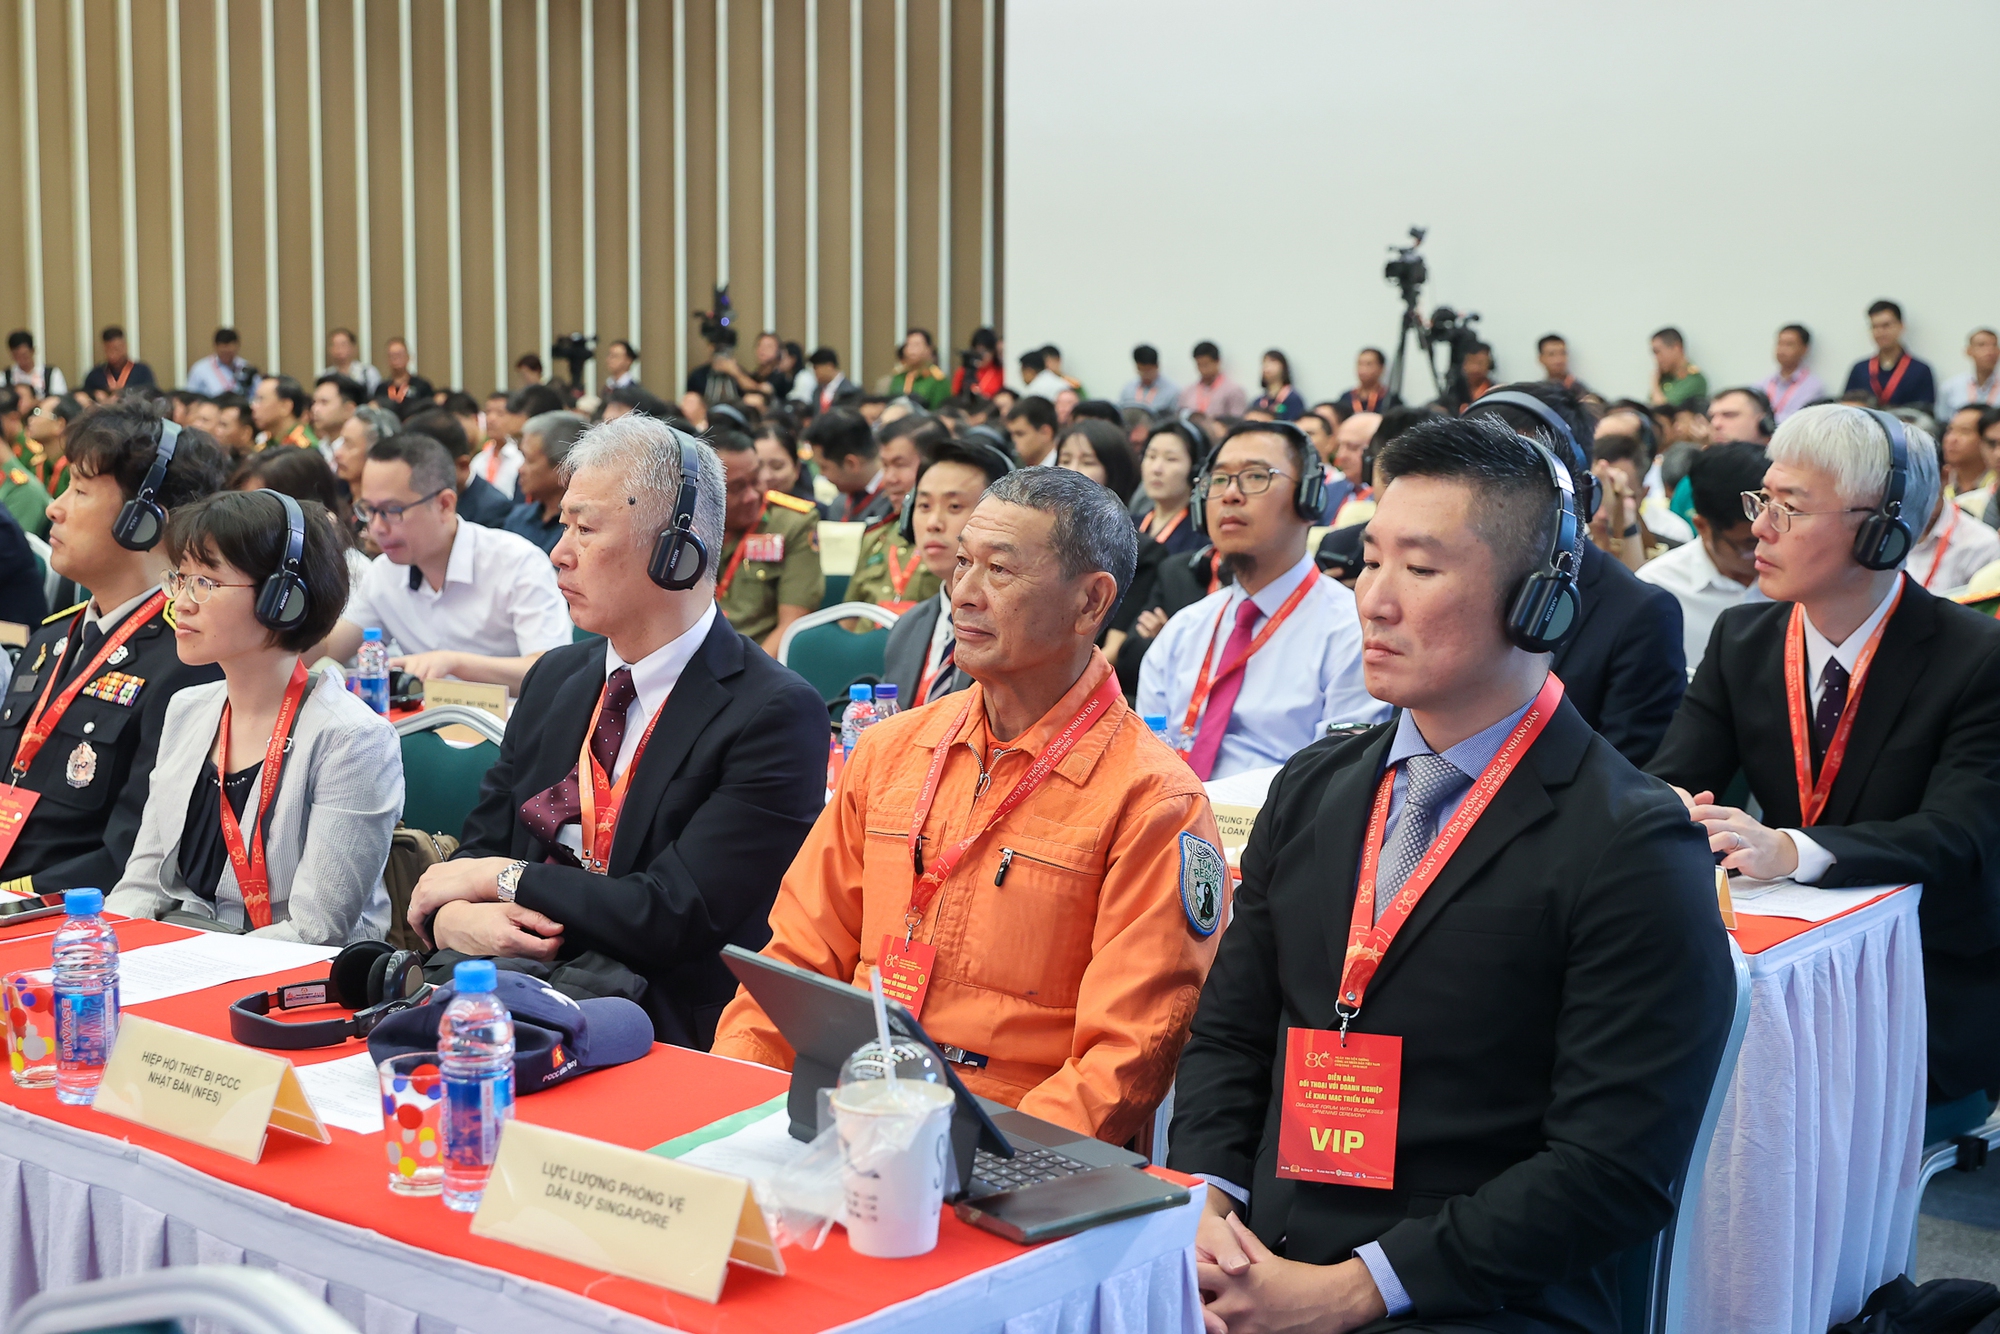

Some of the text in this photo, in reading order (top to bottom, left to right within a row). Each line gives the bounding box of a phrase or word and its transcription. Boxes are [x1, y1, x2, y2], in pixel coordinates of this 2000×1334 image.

[1026, 755, 1049, 781] THỐNG
[1046, 738, 1064, 756] CÔNG
[1063, 728, 1072, 738] AN
[1069, 711, 1088, 731] NHÂN
[1086, 698, 1100, 715] DÂN
[1416, 857, 1437, 881] NGÀY
[1434, 819, 1462, 857] TRUYỀN
[1457, 788, 1483, 821] THỐNG
[1480, 763, 1501, 789] CÔNG
[1497, 750, 1511, 766] AN
[1506, 726, 1529, 754] NHÂN
[1524, 709, 1540, 729] DÂN
[1461, 798, 1487, 832] 19/8/1945
[1486, 762, 1512, 796] 19/8/2025
[1215, 814, 1243, 825] TRUNG
[1222, 826, 1246, 836] LOAN
[1363, 845, 1373, 870] NGÀY
[62, 998, 74, 1060] BIWASE
[141, 1051, 241, 1091] HIỆP HỘI THIẾT BỊ PCCC
[147, 1071, 222, 1106] NHẬT BẢN (NFES)
[1339, 1083, 1360, 1092] DOANH
[1313, 1092, 1327, 1100] KHAI
[1309, 1126, 1365, 1154] VIP
[541, 1161, 686, 1213] LỰC LƯỢNG PHÒNG VỆ
[545, 1183, 671, 1230] DÂN SỰ SINGAPORE
